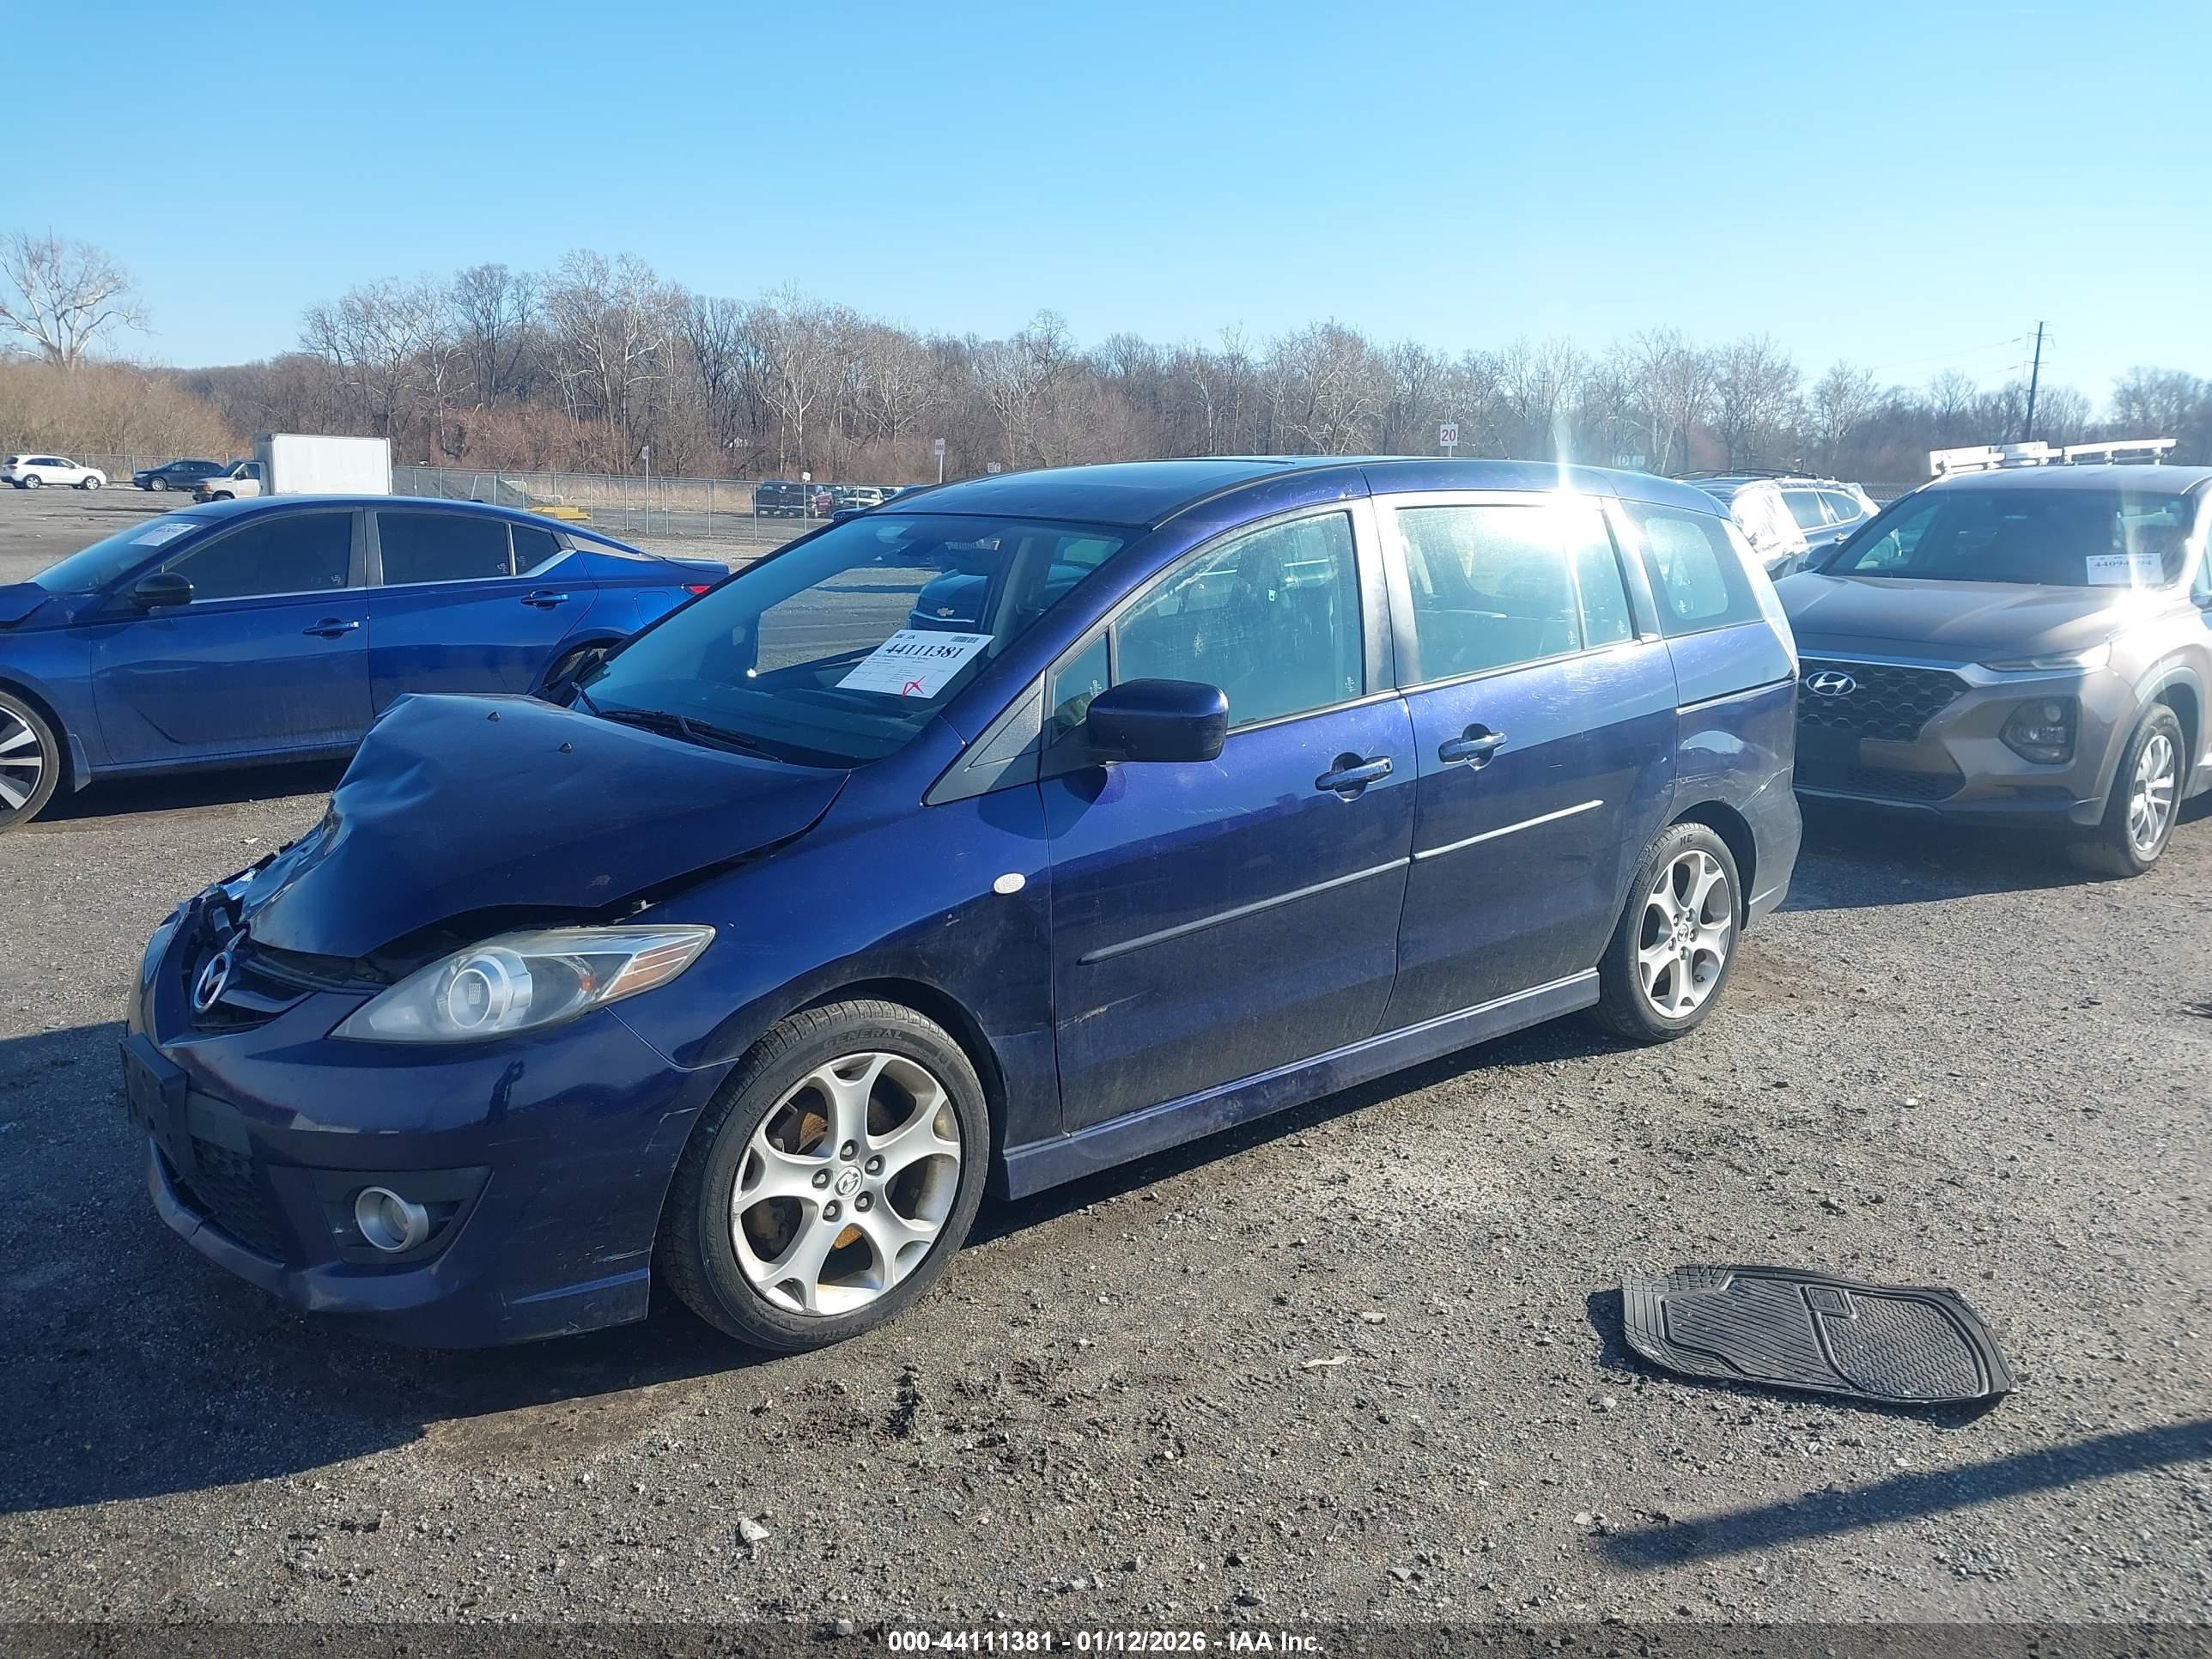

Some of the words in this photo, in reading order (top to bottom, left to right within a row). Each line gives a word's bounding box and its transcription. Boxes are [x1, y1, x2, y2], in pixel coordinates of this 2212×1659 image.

[1442, 428, 1456, 441] 20
[885, 643, 964, 659] 44111381
[823, 1028, 902, 1048] GENERAL
